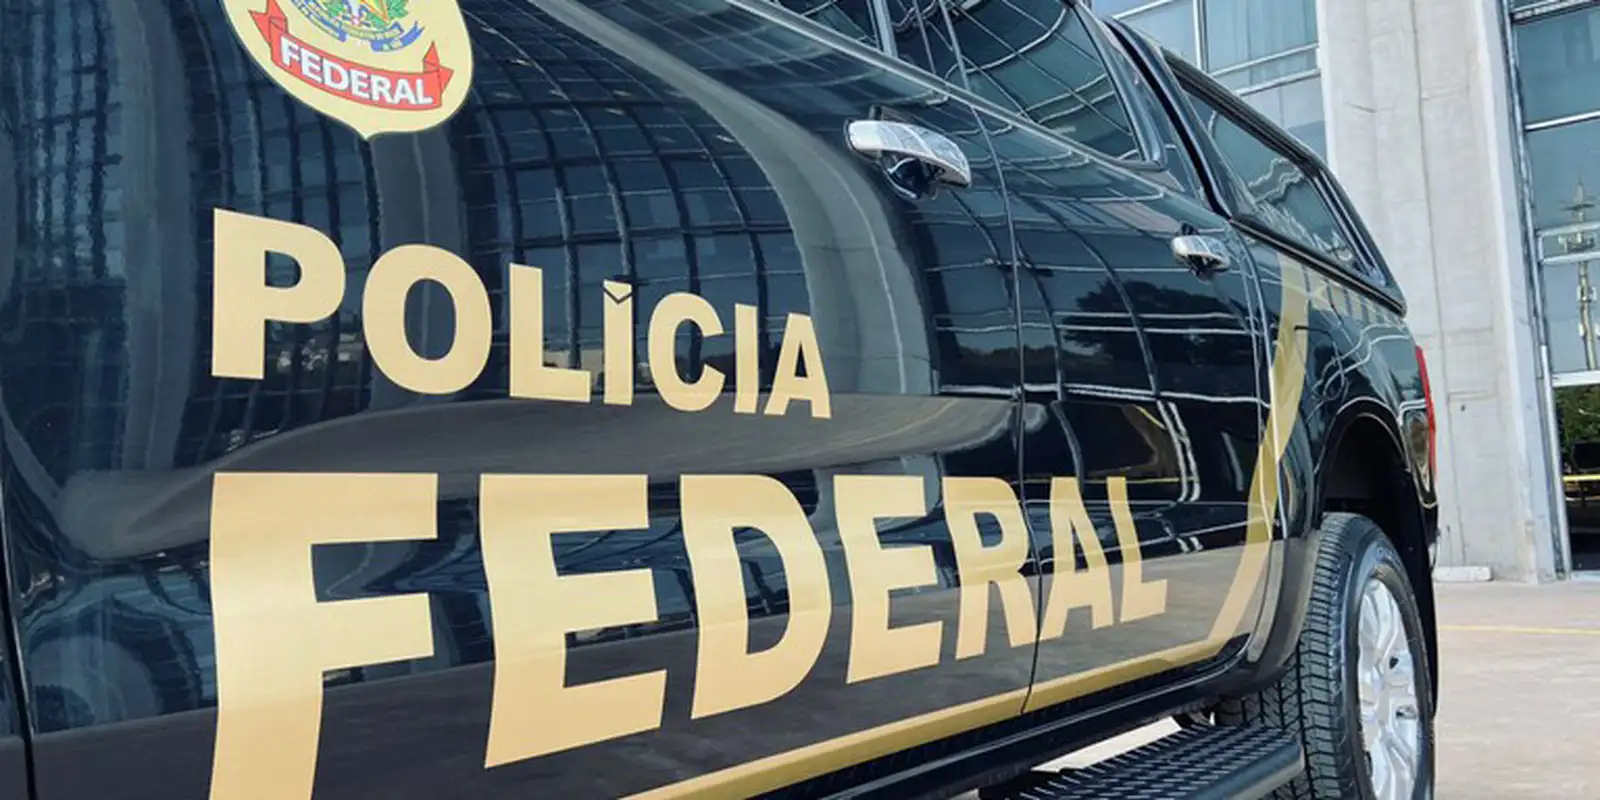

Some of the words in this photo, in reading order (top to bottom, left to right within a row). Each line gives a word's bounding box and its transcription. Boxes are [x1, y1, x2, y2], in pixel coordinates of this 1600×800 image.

[279, 35, 435, 105] FEDERAL
[211, 208, 832, 419] POLÍCIA
[208, 472, 1167, 800] FEDERAL
